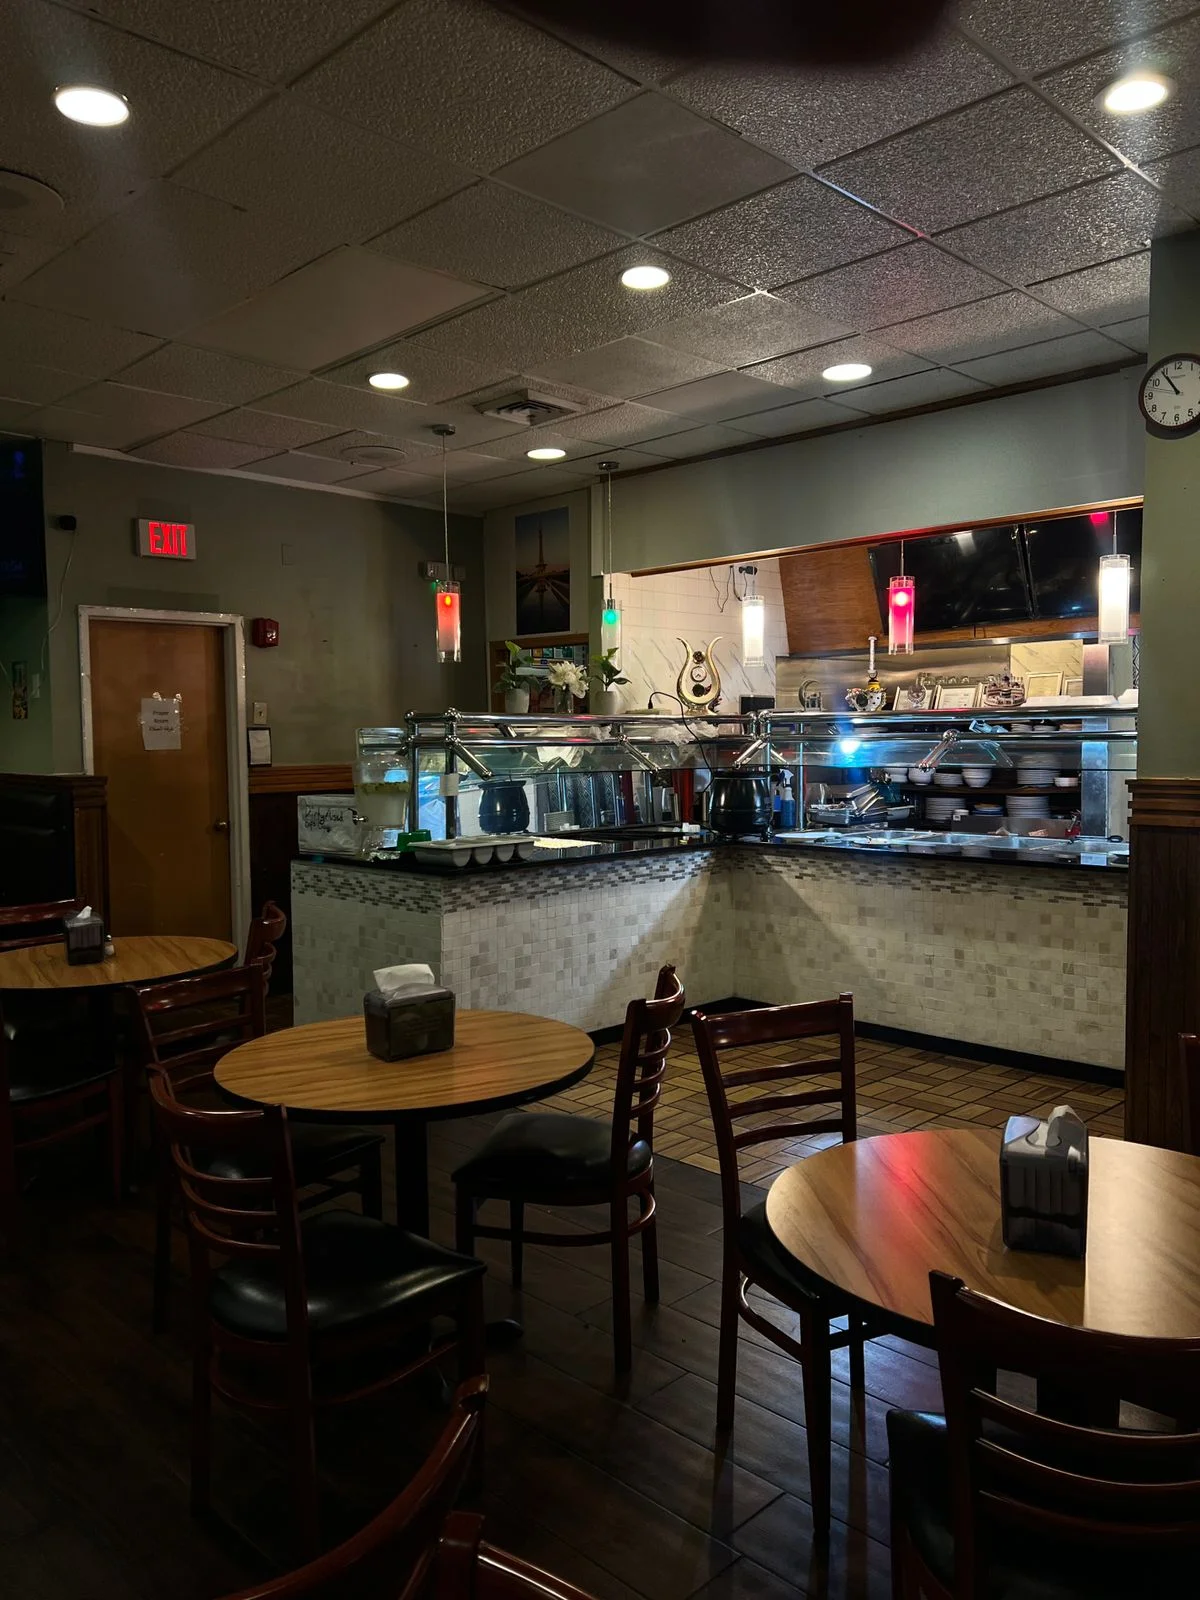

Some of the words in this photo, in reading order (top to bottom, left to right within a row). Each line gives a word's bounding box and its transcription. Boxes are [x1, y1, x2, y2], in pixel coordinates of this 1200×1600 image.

[1174, 361, 1182, 370] 12
[1152, 378, 1160, 386] 10
[1148, 392, 1154, 400] 9
[1152, 404, 1157, 412] 8
[1188, 408, 1194, 416] 5
[1161, 412, 1166, 420] 7
[1174, 414, 1180, 422] 6
[150, 522, 187, 556] EXIT
